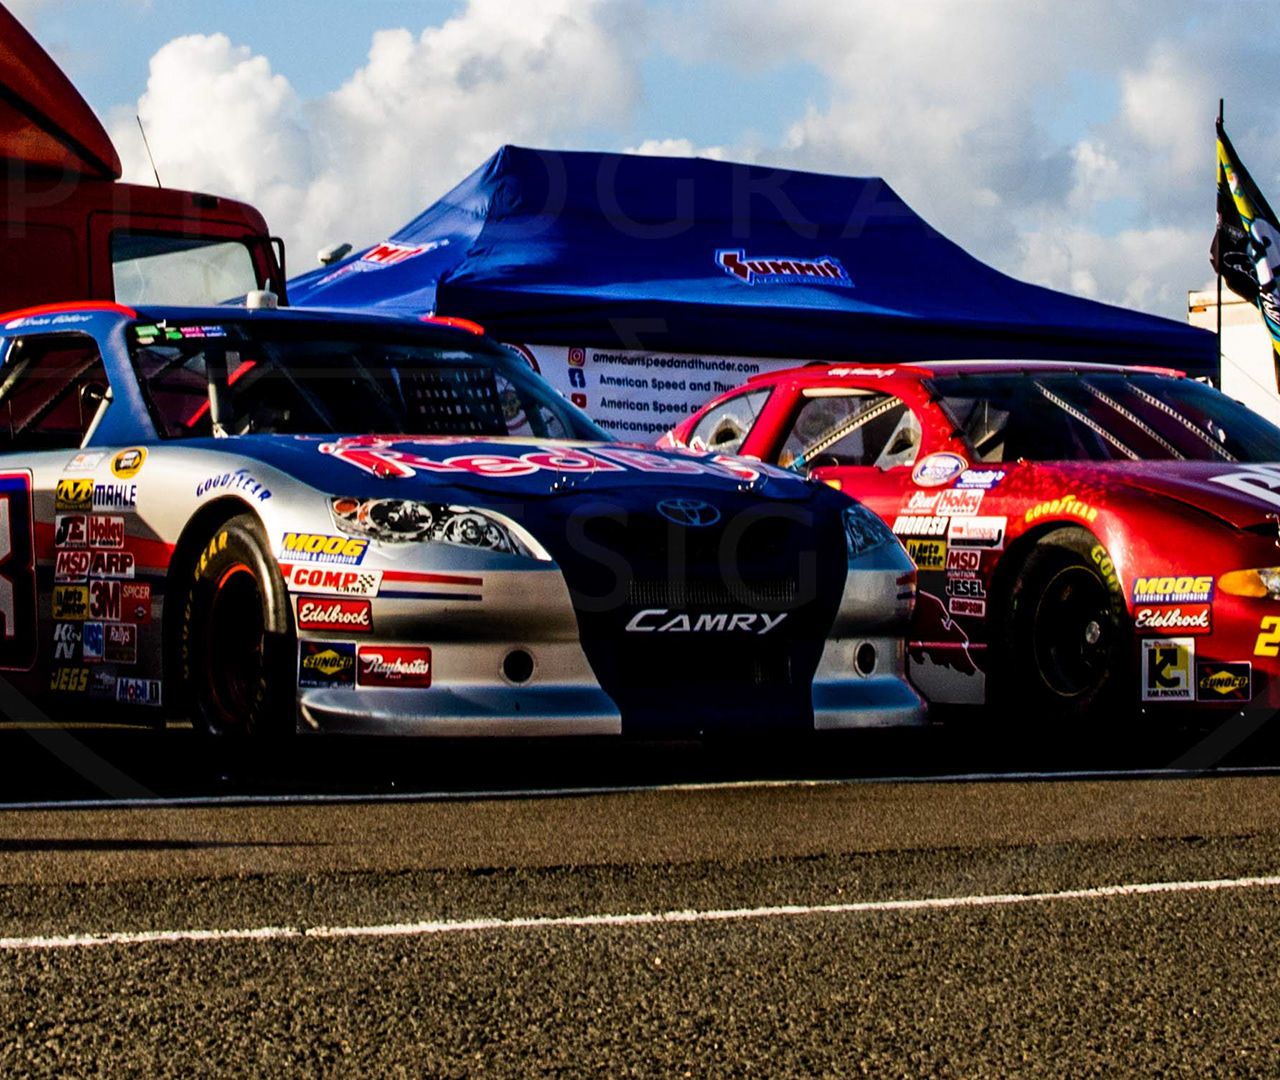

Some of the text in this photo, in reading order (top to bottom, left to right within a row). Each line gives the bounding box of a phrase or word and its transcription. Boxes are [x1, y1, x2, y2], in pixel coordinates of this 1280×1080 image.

[593, 352, 760, 373] americanspeedandthunder.com
[599, 374, 735, 394] American Speed and Thun
[600, 397, 650, 411] American
[652, 401, 688, 415] Speed
[593, 418, 677, 434] americanspeed
[94, 484, 137, 506] MAHLE
[196, 468, 272, 502] GOODYEAR
[940, 490, 981, 513] Holley
[1025, 494, 1098, 523] GOODYEAR
[56, 516, 86, 546] JE
[282, 533, 368, 557] MOOG
[917, 542, 939, 554] Auto
[57, 552, 88, 574] MSD
[91, 553, 134, 574] ARP
[948, 552, 978, 569] MSD
[293, 569, 359, 588] COMP
[947, 570, 977, 579] IGNITION
[122, 585, 151, 600] SPICER
[336, 585, 368, 594] CAMS
[946, 580, 986, 597] JESEL
[1133, 576, 1214, 595] MOOG
[90, 582, 119, 619] 3M
[951, 601, 983, 613] SIMPSON
[299, 602, 370, 626] Edelbrock
[625, 609, 788, 634] CAMRY
[1135, 608, 1210, 628] Edelbrock
[303, 654, 353, 669] SUNOCO
[50, 666, 90, 692] JEGS
[1200, 675, 1249, 689] SUNOCO
[119, 679, 148, 700] Mobil
